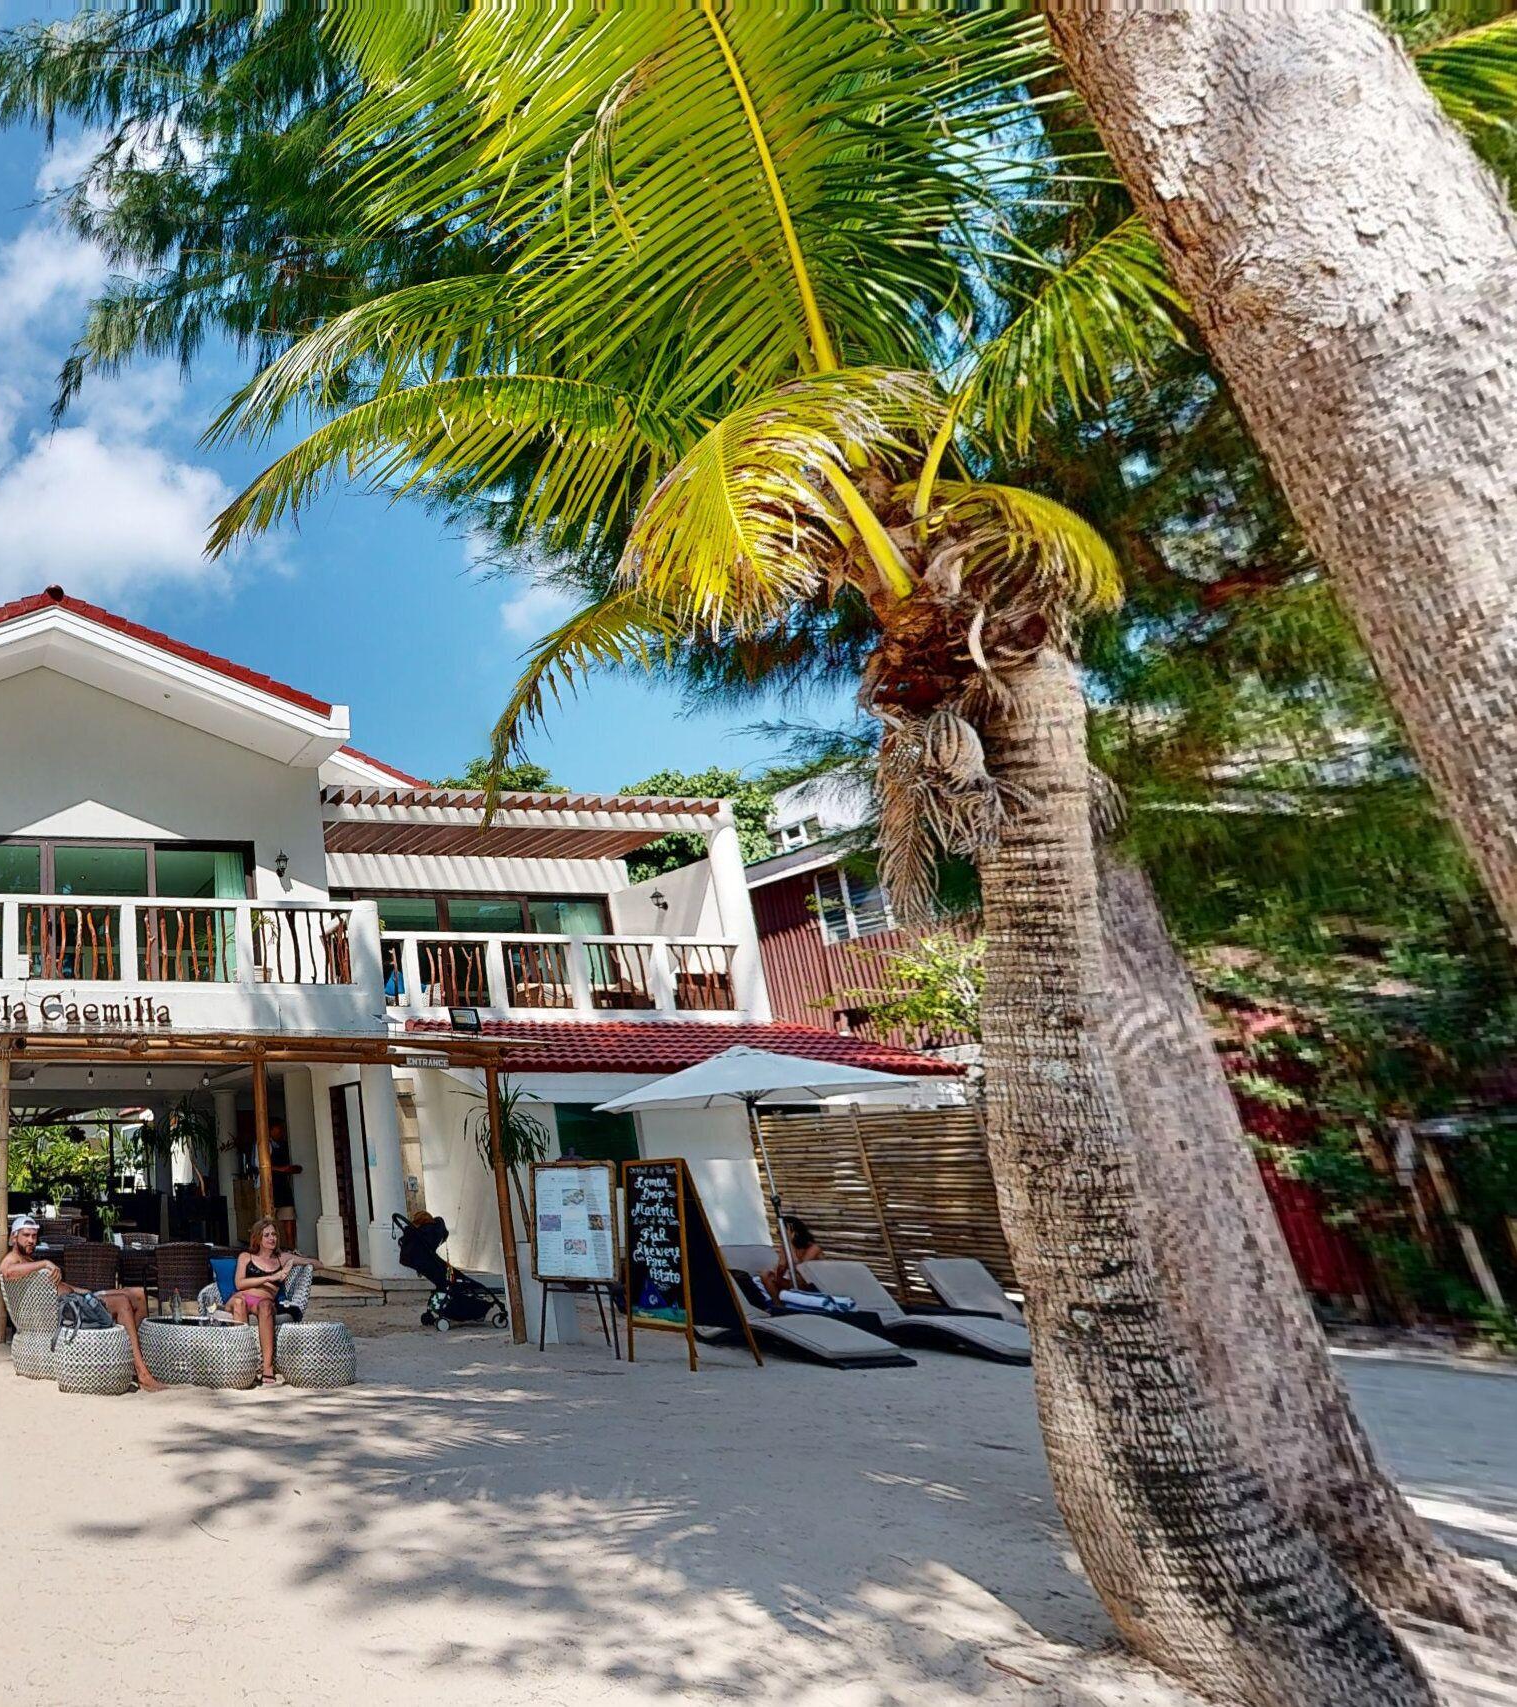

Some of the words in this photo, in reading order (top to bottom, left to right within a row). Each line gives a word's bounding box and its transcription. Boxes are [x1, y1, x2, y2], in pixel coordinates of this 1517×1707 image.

[39, 994, 172, 1024] Caemilla
[406, 1056, 449, 1067] ENTRANCE
[634, 1176, 671, 1189] Lemon
[631, 1202, 675, 1218] Martini
[649, 1267, 681, 1284] Potato
